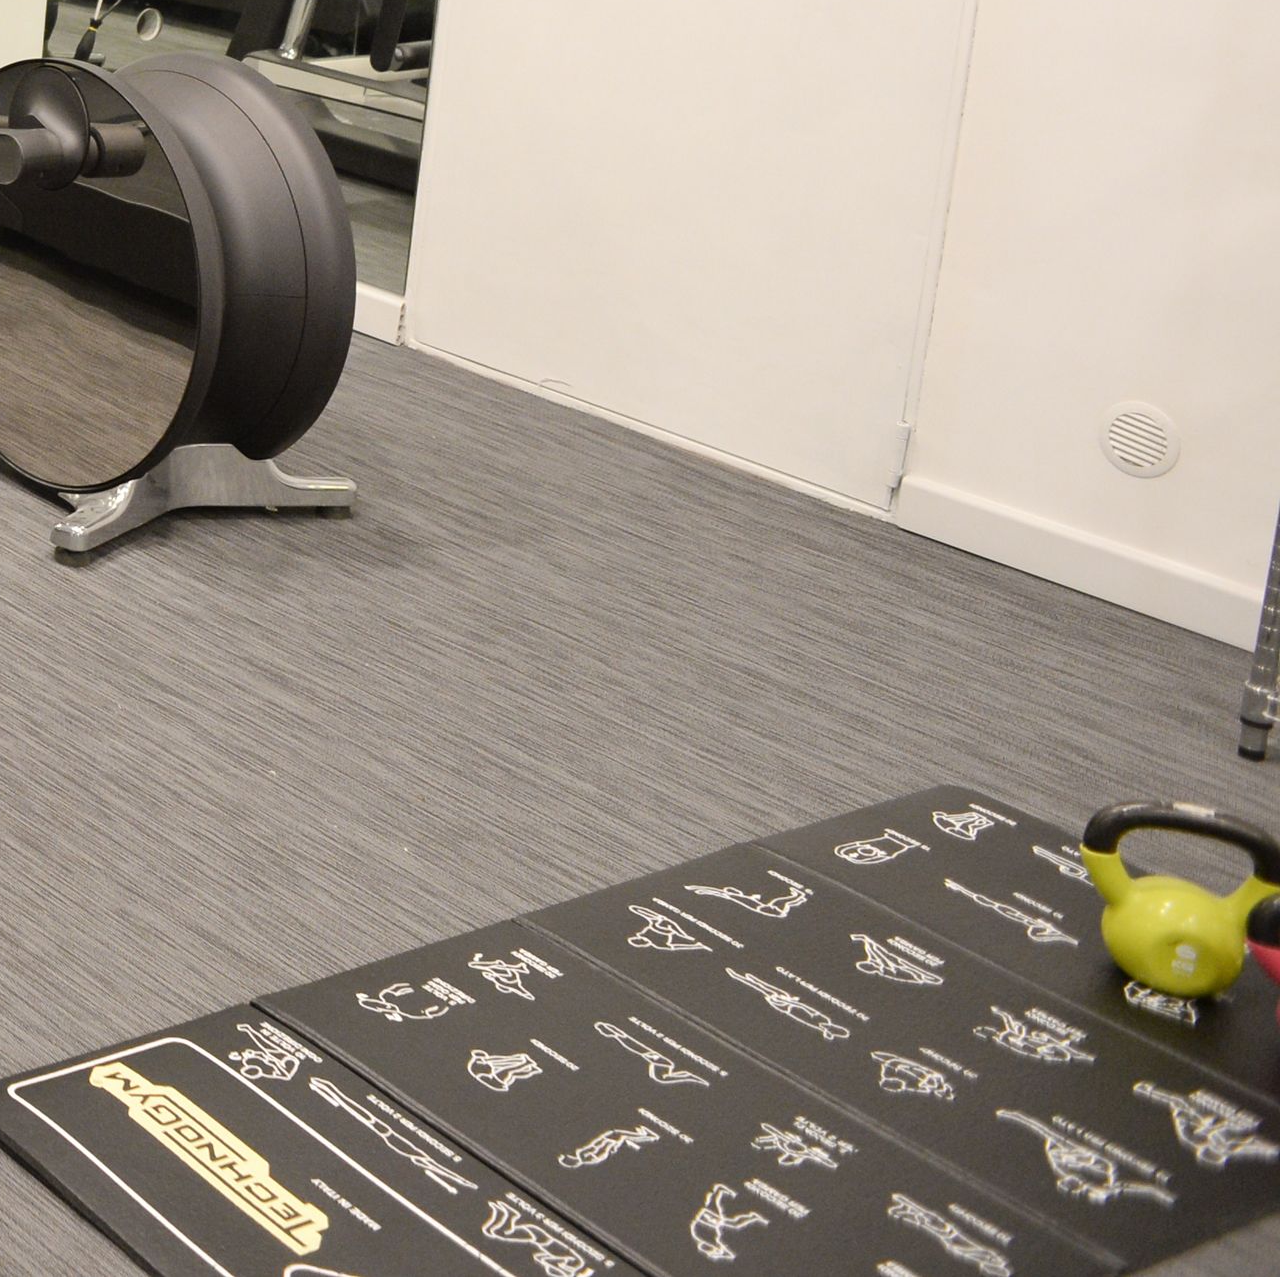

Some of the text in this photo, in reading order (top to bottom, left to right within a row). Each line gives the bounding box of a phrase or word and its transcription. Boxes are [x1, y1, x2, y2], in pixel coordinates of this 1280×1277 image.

[104, 1070, 314, 1248] TECHNOGYM
[310, 1178, 340, 1201] ITALY
[349, 1206, 382, 1231] MADE
